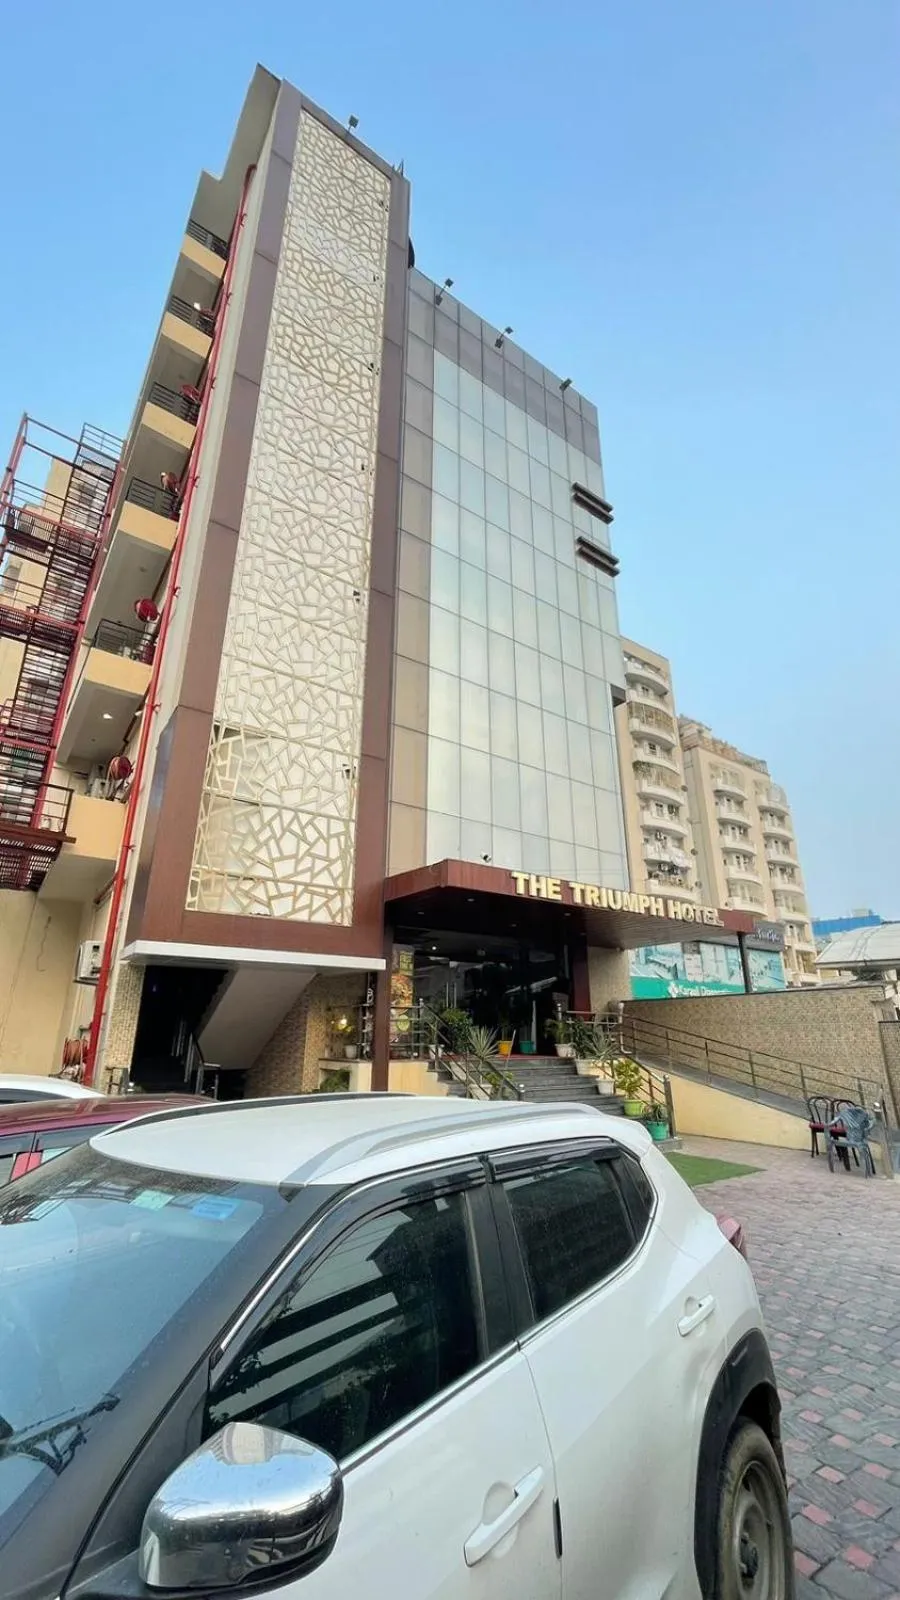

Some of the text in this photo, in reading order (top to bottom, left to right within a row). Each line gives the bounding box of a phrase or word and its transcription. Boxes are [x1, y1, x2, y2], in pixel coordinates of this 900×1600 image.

[511, 871, 724, 927] THE TRIUMPH HOTEL
